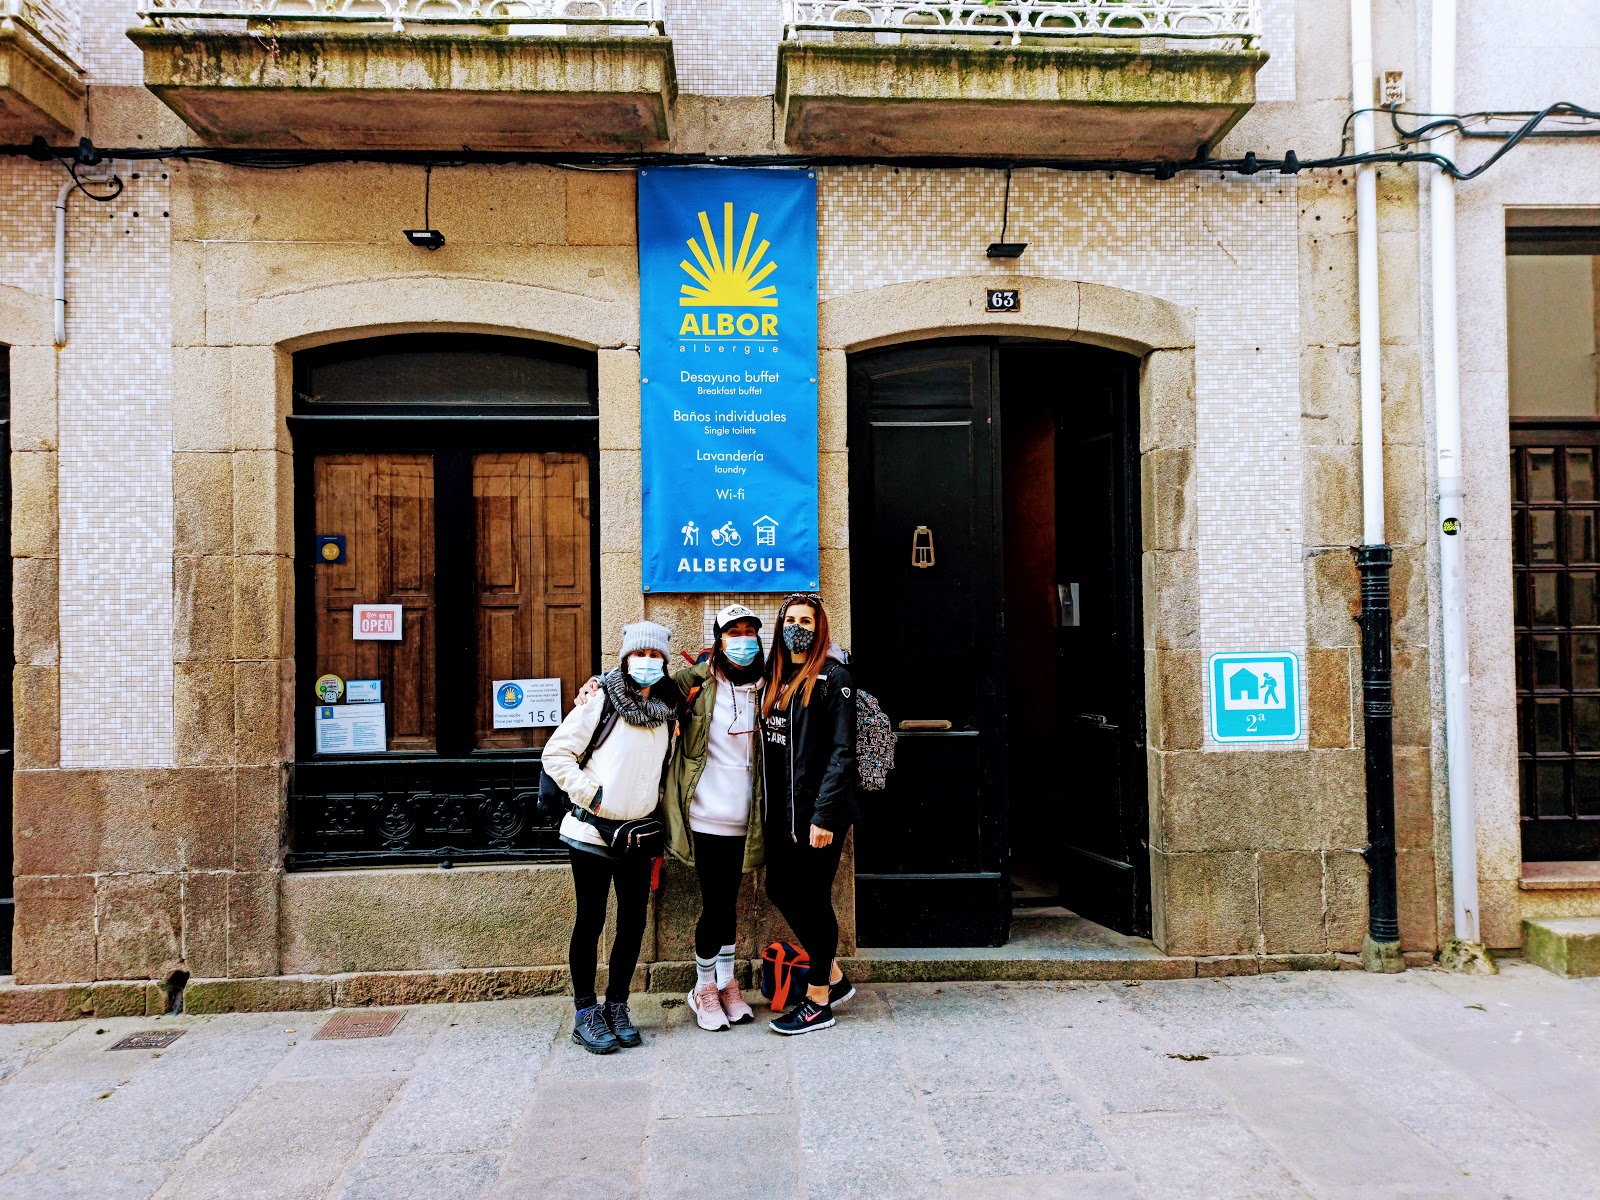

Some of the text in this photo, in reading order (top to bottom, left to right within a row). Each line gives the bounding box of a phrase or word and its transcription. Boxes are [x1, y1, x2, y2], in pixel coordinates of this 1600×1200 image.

[992, 292, 1014, 307] 63
[679, 313, 778, 336] ALBOR
[679, 344, 778, 355] albergue
[680, 370, 780, 385] Desayuno buffet
[697, 387, 762, 395] Breakfast buffet
[673, 410, 787, 422] Baños individuales
[704, 426, 756, 436] Single toilets
[696, 450, 764, 462] Lavandería
[714, 465, 746, 475] laundry
[715, 488, 745, 500] Wi-fi
[324, 548, 338, 556] 8,7
[677, 558, 785, 573] ALBERGUE
[361, 619, 393, 632] OPEN
[528, 710, 557, 723] 15 €
